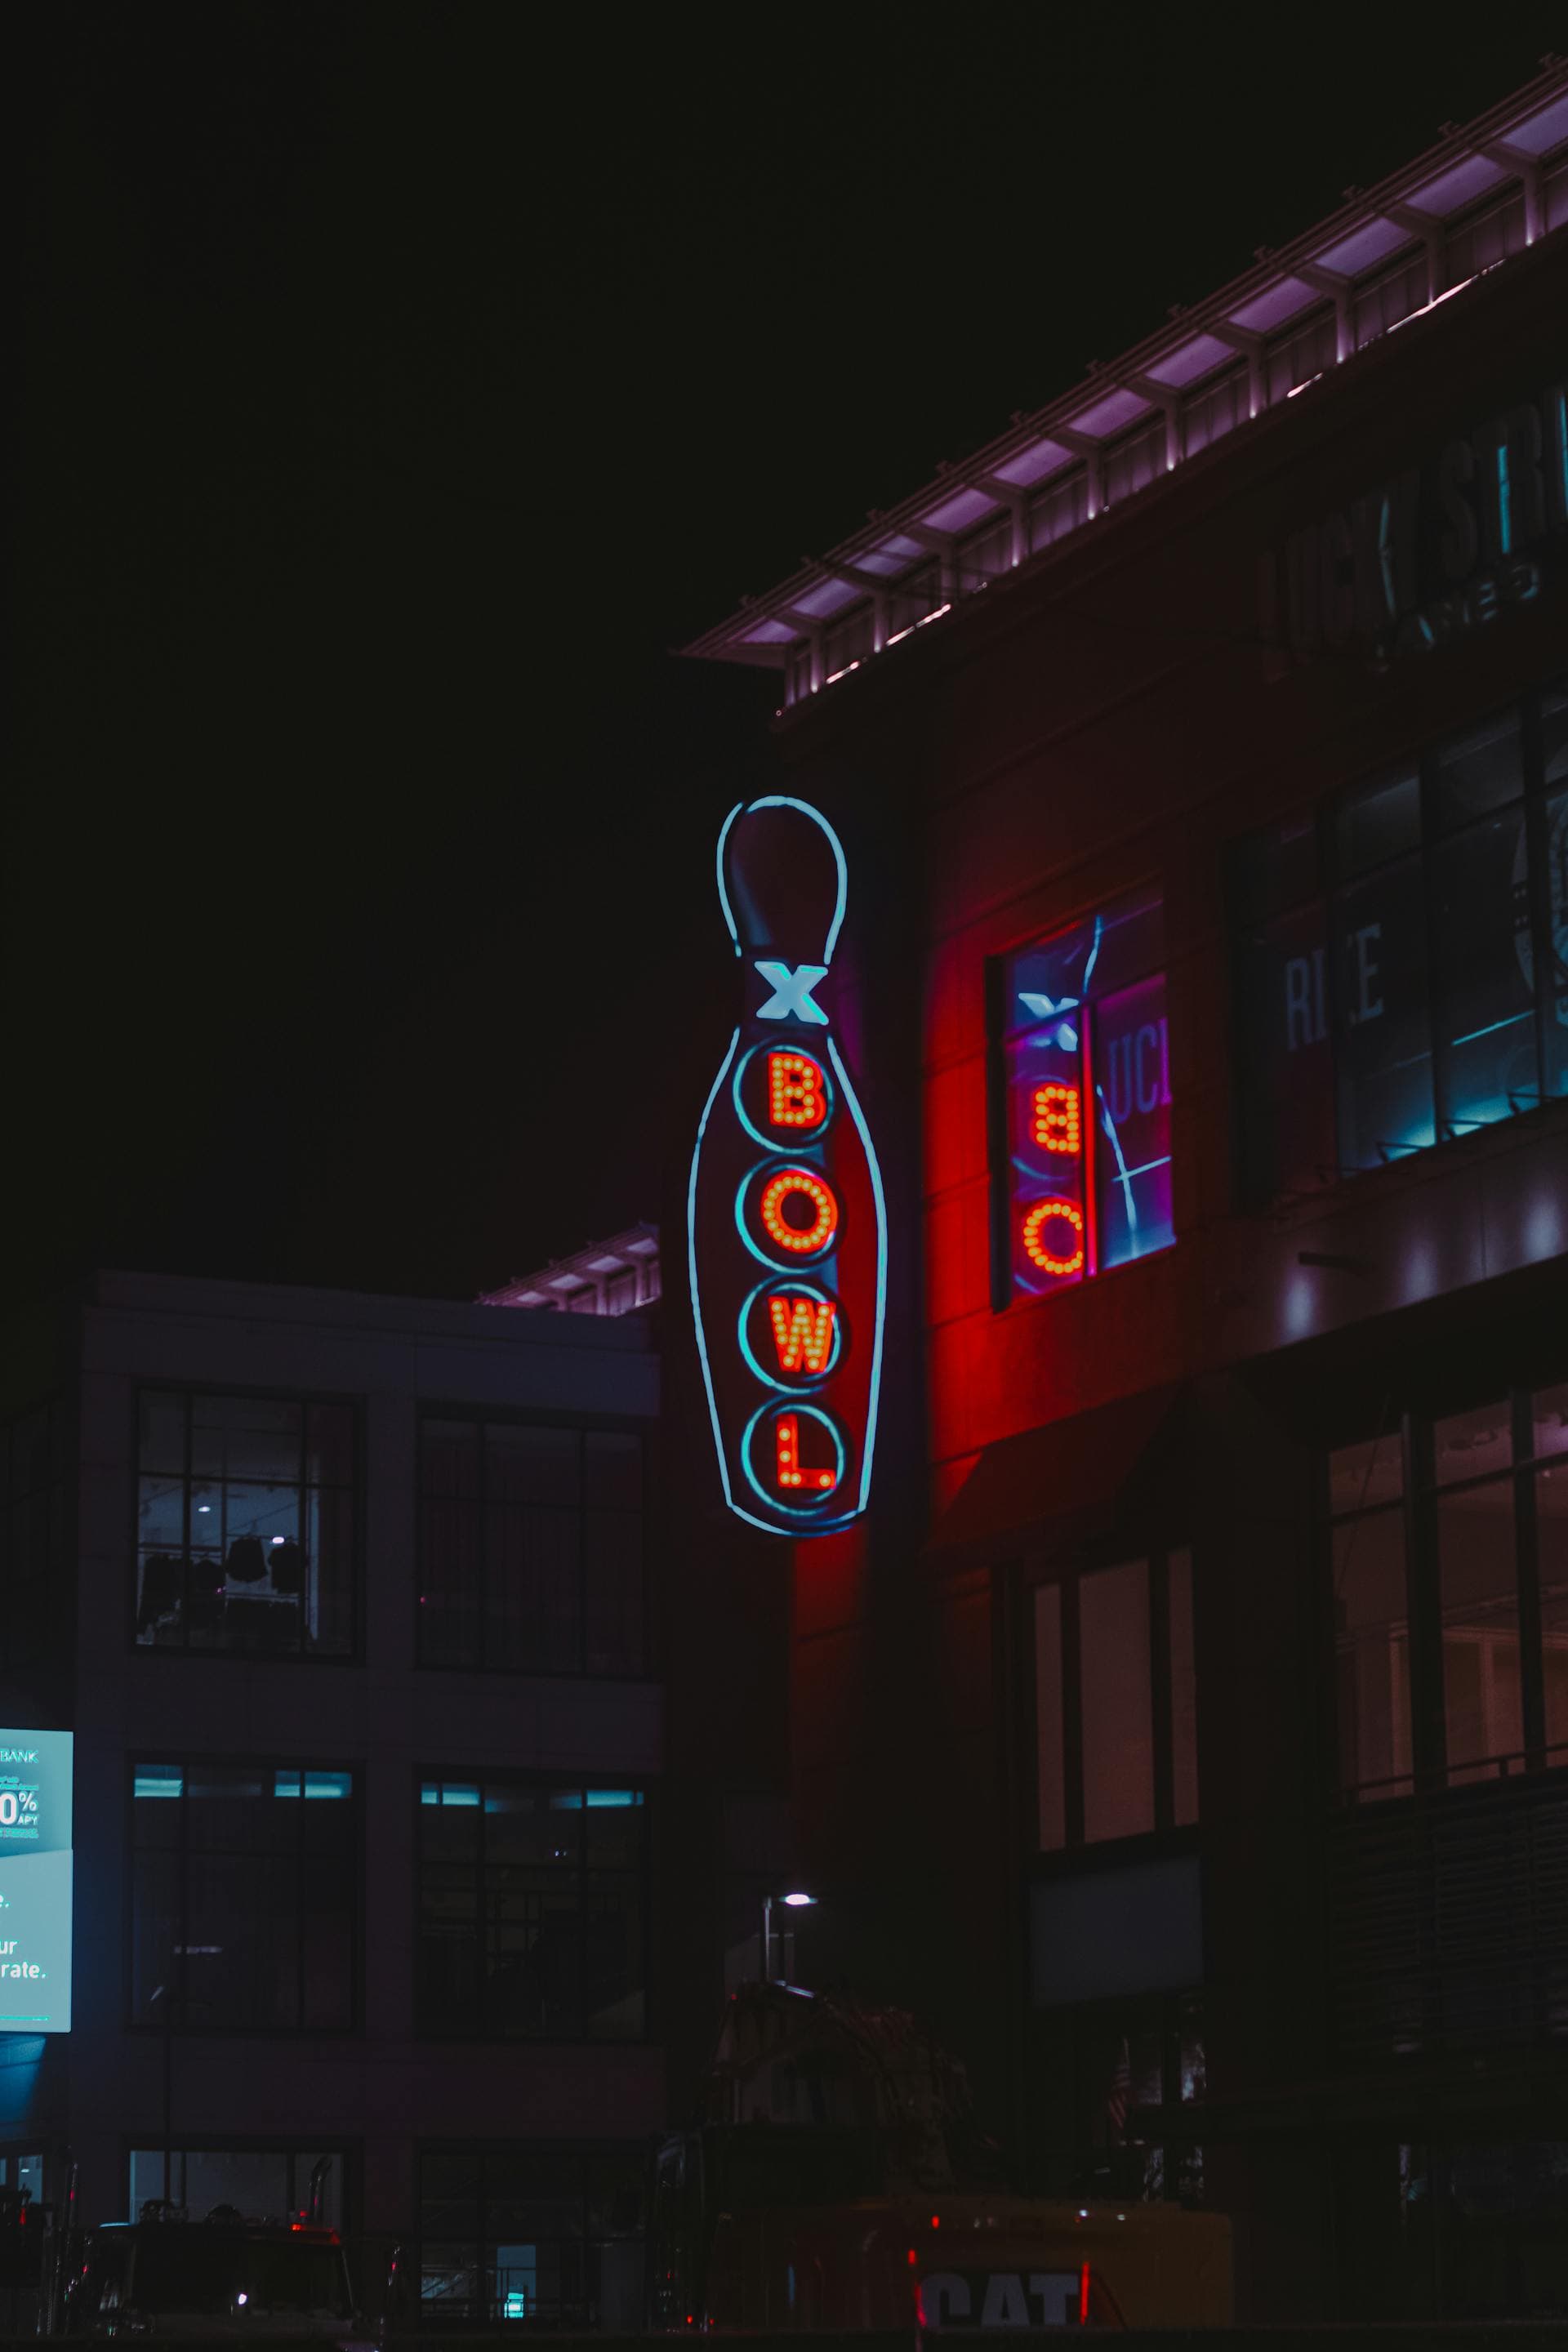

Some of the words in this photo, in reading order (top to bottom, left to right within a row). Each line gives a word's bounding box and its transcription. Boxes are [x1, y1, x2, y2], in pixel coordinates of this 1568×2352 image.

[760, 1052, 839, 1490] BOWL
[17, 1815, 38, 1825] APY
[1, 1962, 47, 1979] rate.
[924, 2271, 1078, 2327] CAT
